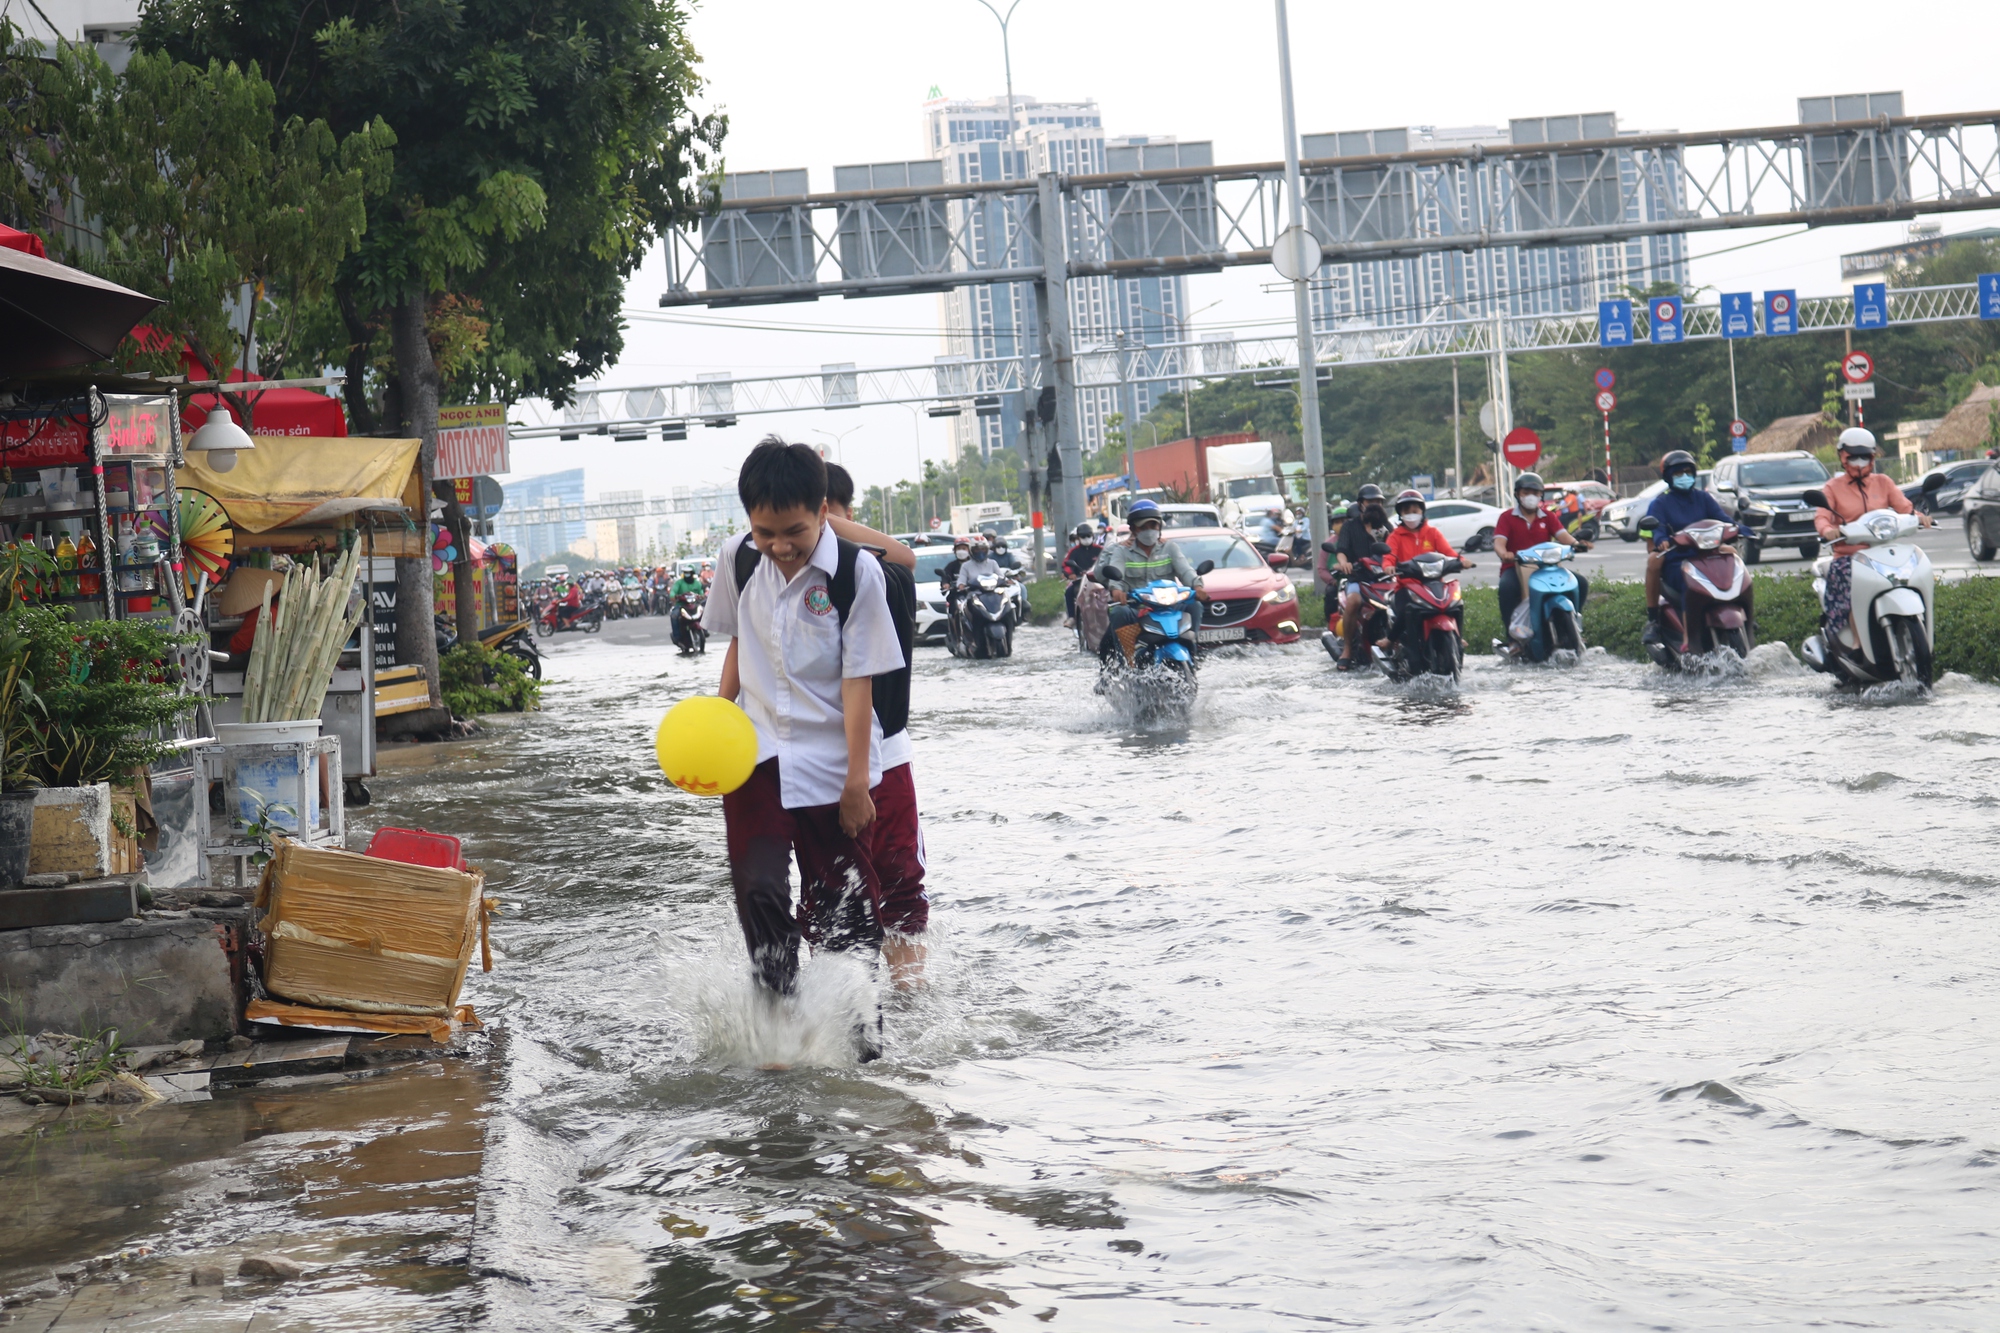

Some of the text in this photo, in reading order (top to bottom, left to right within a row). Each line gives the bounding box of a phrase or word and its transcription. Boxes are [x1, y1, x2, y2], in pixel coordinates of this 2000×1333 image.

[1776, 299, 1786, 309] 60
[1661, 306, 1671, 317] 80
[440, 410, 472, 421] NGỌC
[107, 415, 139, 448] Sinh
[288, 424, 310, 435] sản
[455, 479, 470, 489] XE
[82, 555, 96, 568] C2
